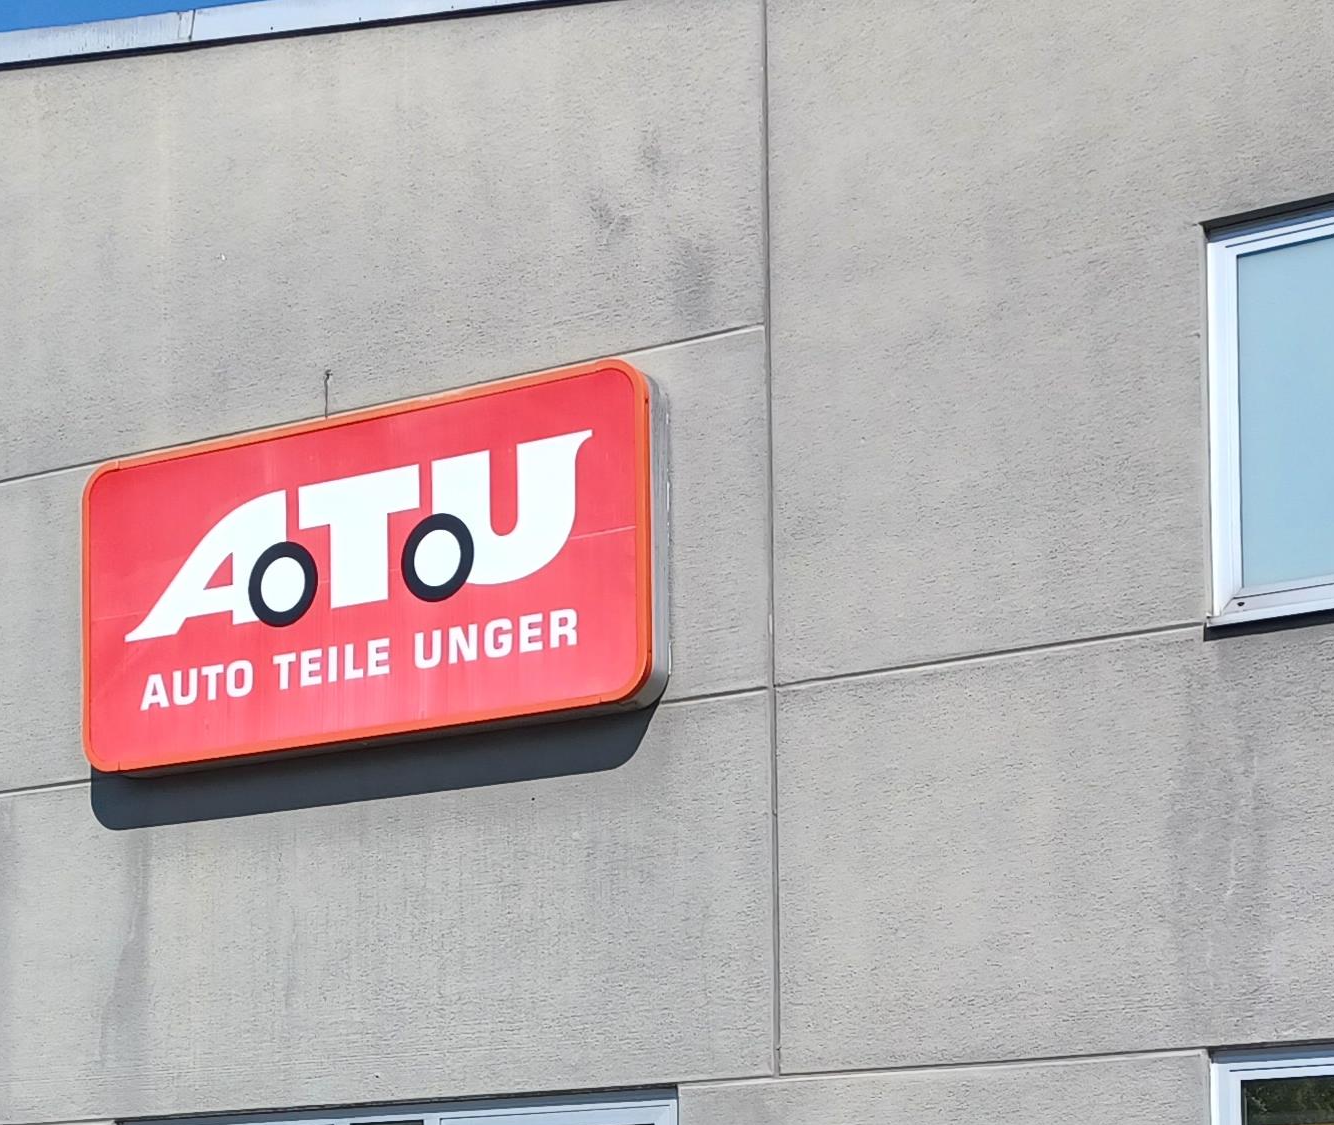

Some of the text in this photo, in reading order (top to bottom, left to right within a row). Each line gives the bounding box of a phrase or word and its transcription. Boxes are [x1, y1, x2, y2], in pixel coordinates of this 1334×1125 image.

[140, 608, 579, 712] AUTO TEILE UNGER
